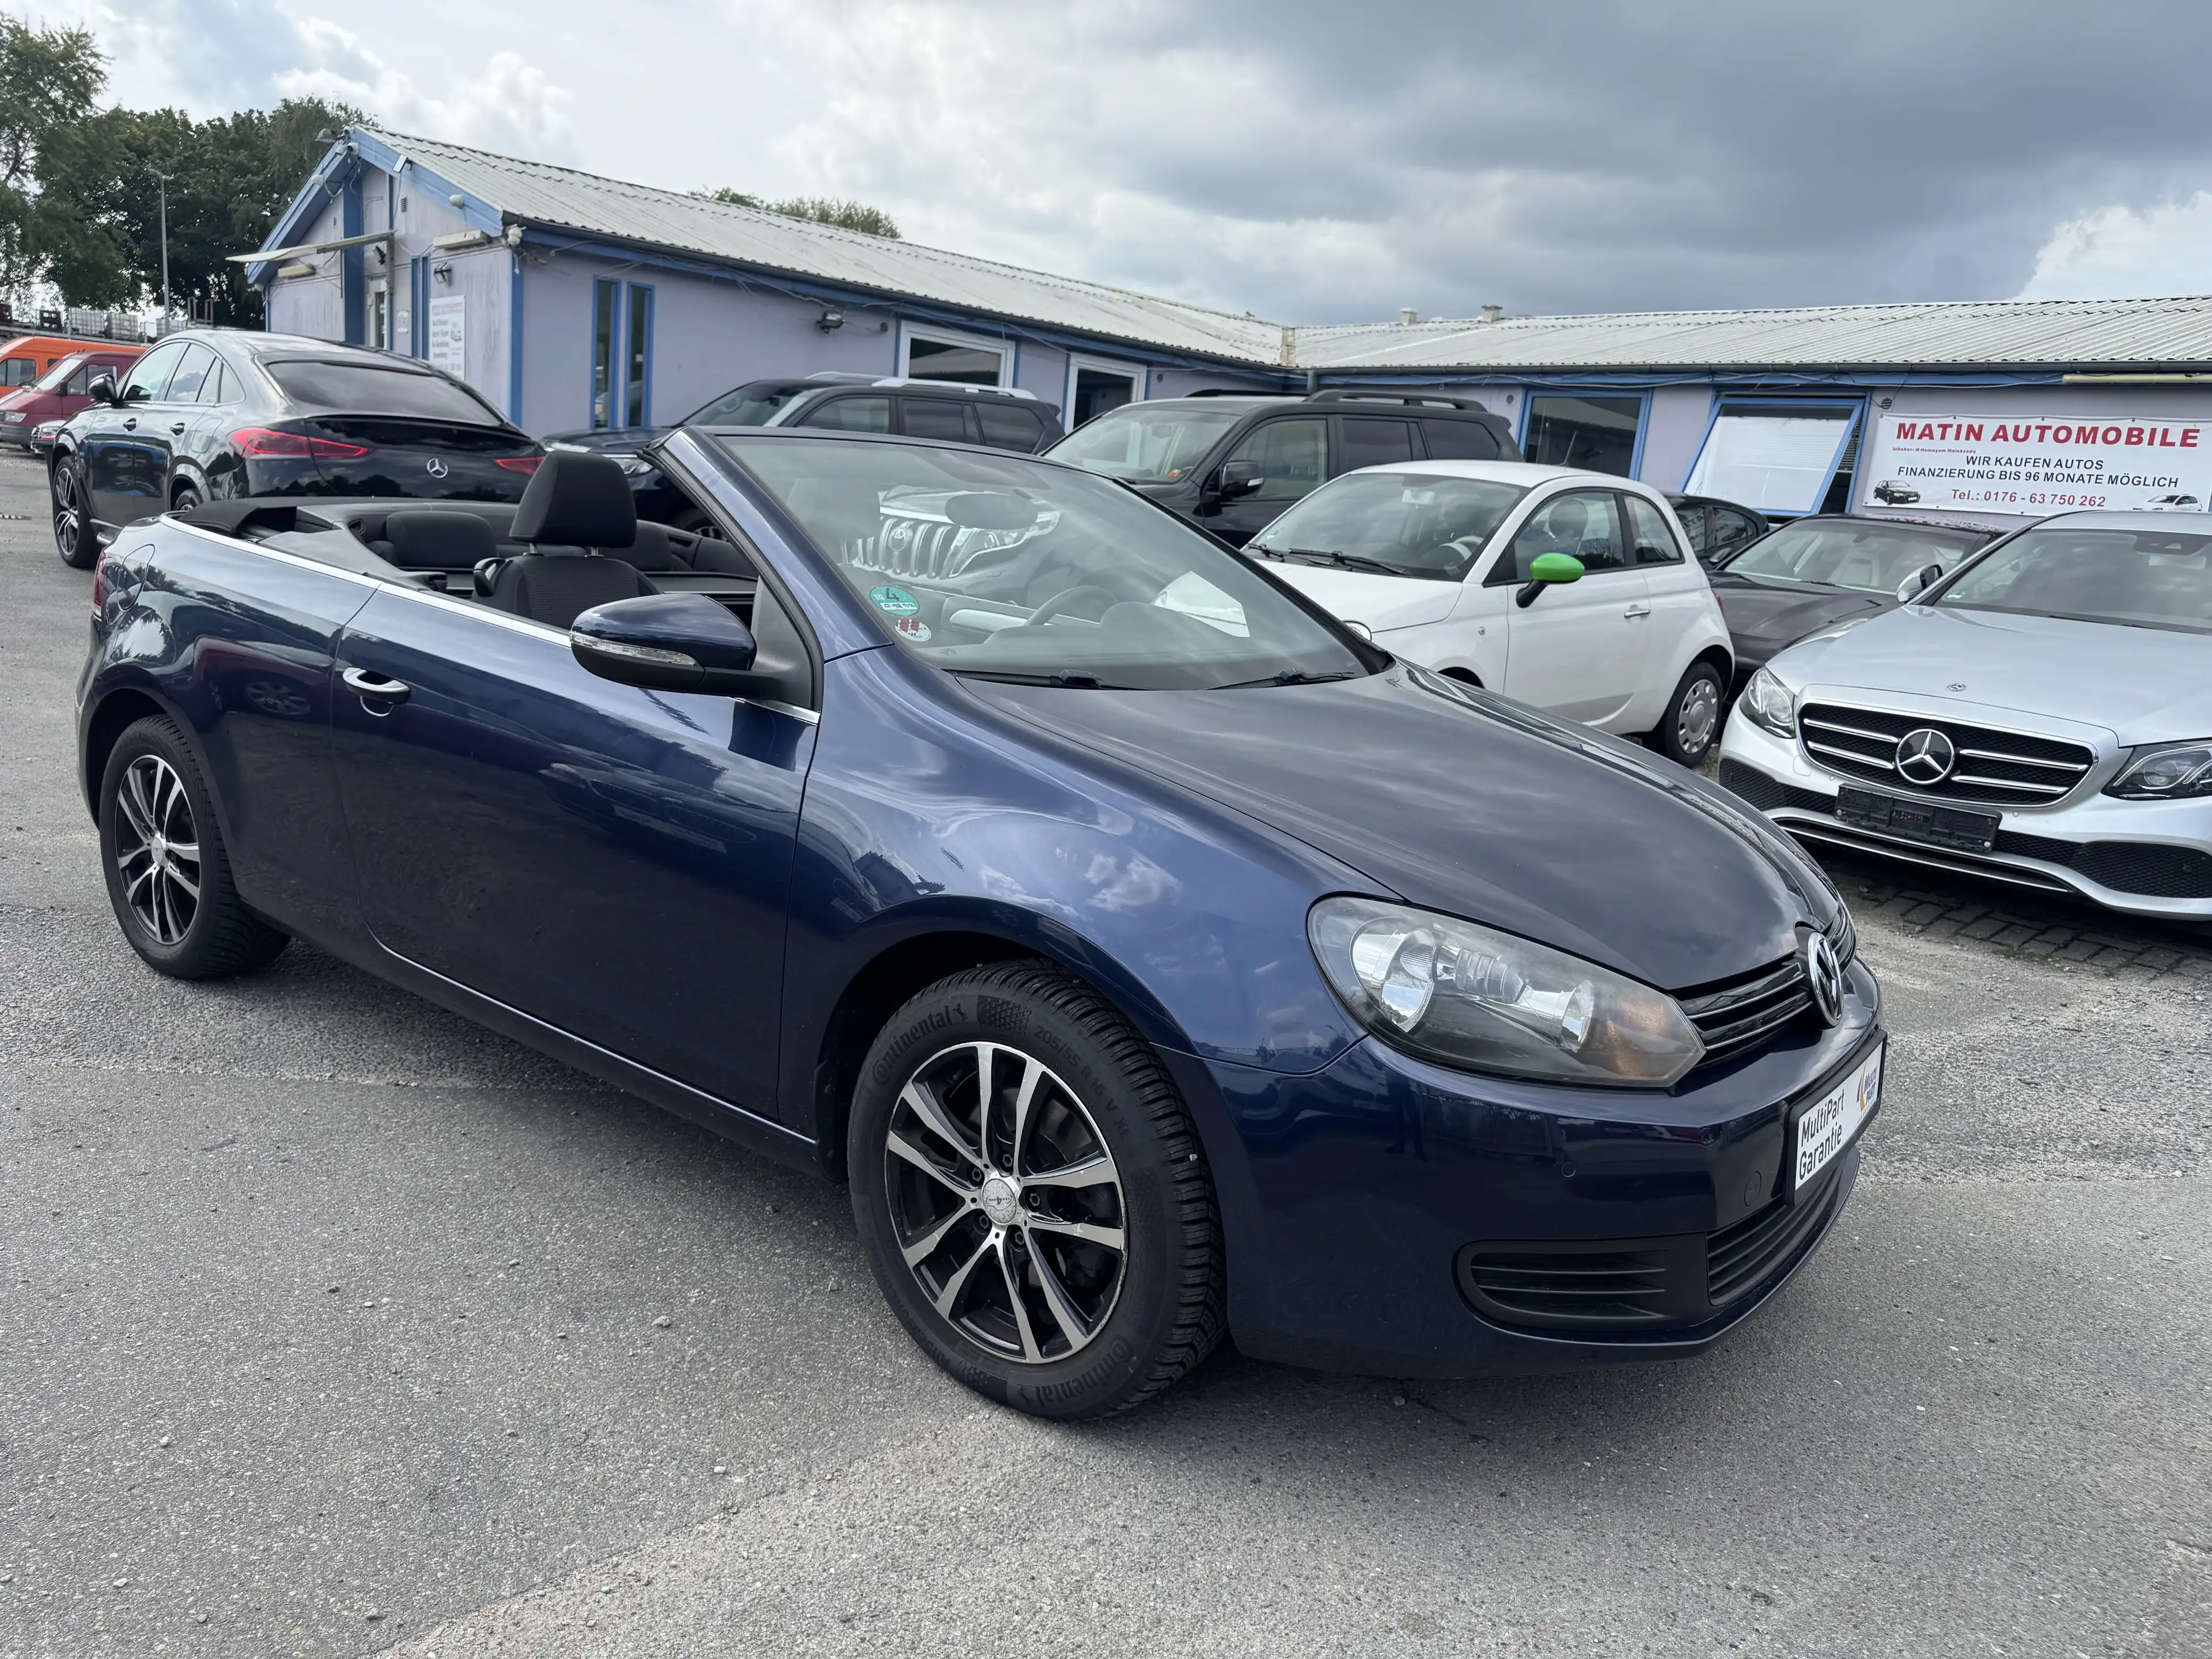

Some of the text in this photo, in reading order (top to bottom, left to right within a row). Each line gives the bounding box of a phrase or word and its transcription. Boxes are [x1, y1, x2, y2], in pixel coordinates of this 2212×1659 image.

[1896, 422, 2200, 448] MATIN AUTOMOBILE
[1966, 455, 2104, 470] WIR KAUFEN AUTOS
[1897, 467, 2179, 488] FINANZIERUNG BIS 96 MONATE MÖGLICH
[1952, 489, 1979, 501] Tel.:
[1984, 491, 2017, 502] 0176
[2029, 493, 2046, 504] 63
[2050, 494, 2075, 506] 750
[2078, 495, 2106, 507] 262
[872, 1005, 955, 1085] Continental
[1033, 1024, 1082, 1067] 205/55
[1080, 1065, 1093, 1081] R
[1090, 1077, 1107, 1097] 16
[1105, 1098, 1119, 1112] V
[1801, 1088, 1844, 1147] MultiPart
[1799, 1122, 1842, 1181] Garantie
[1034, 1335, 1135, 1408] Continental
